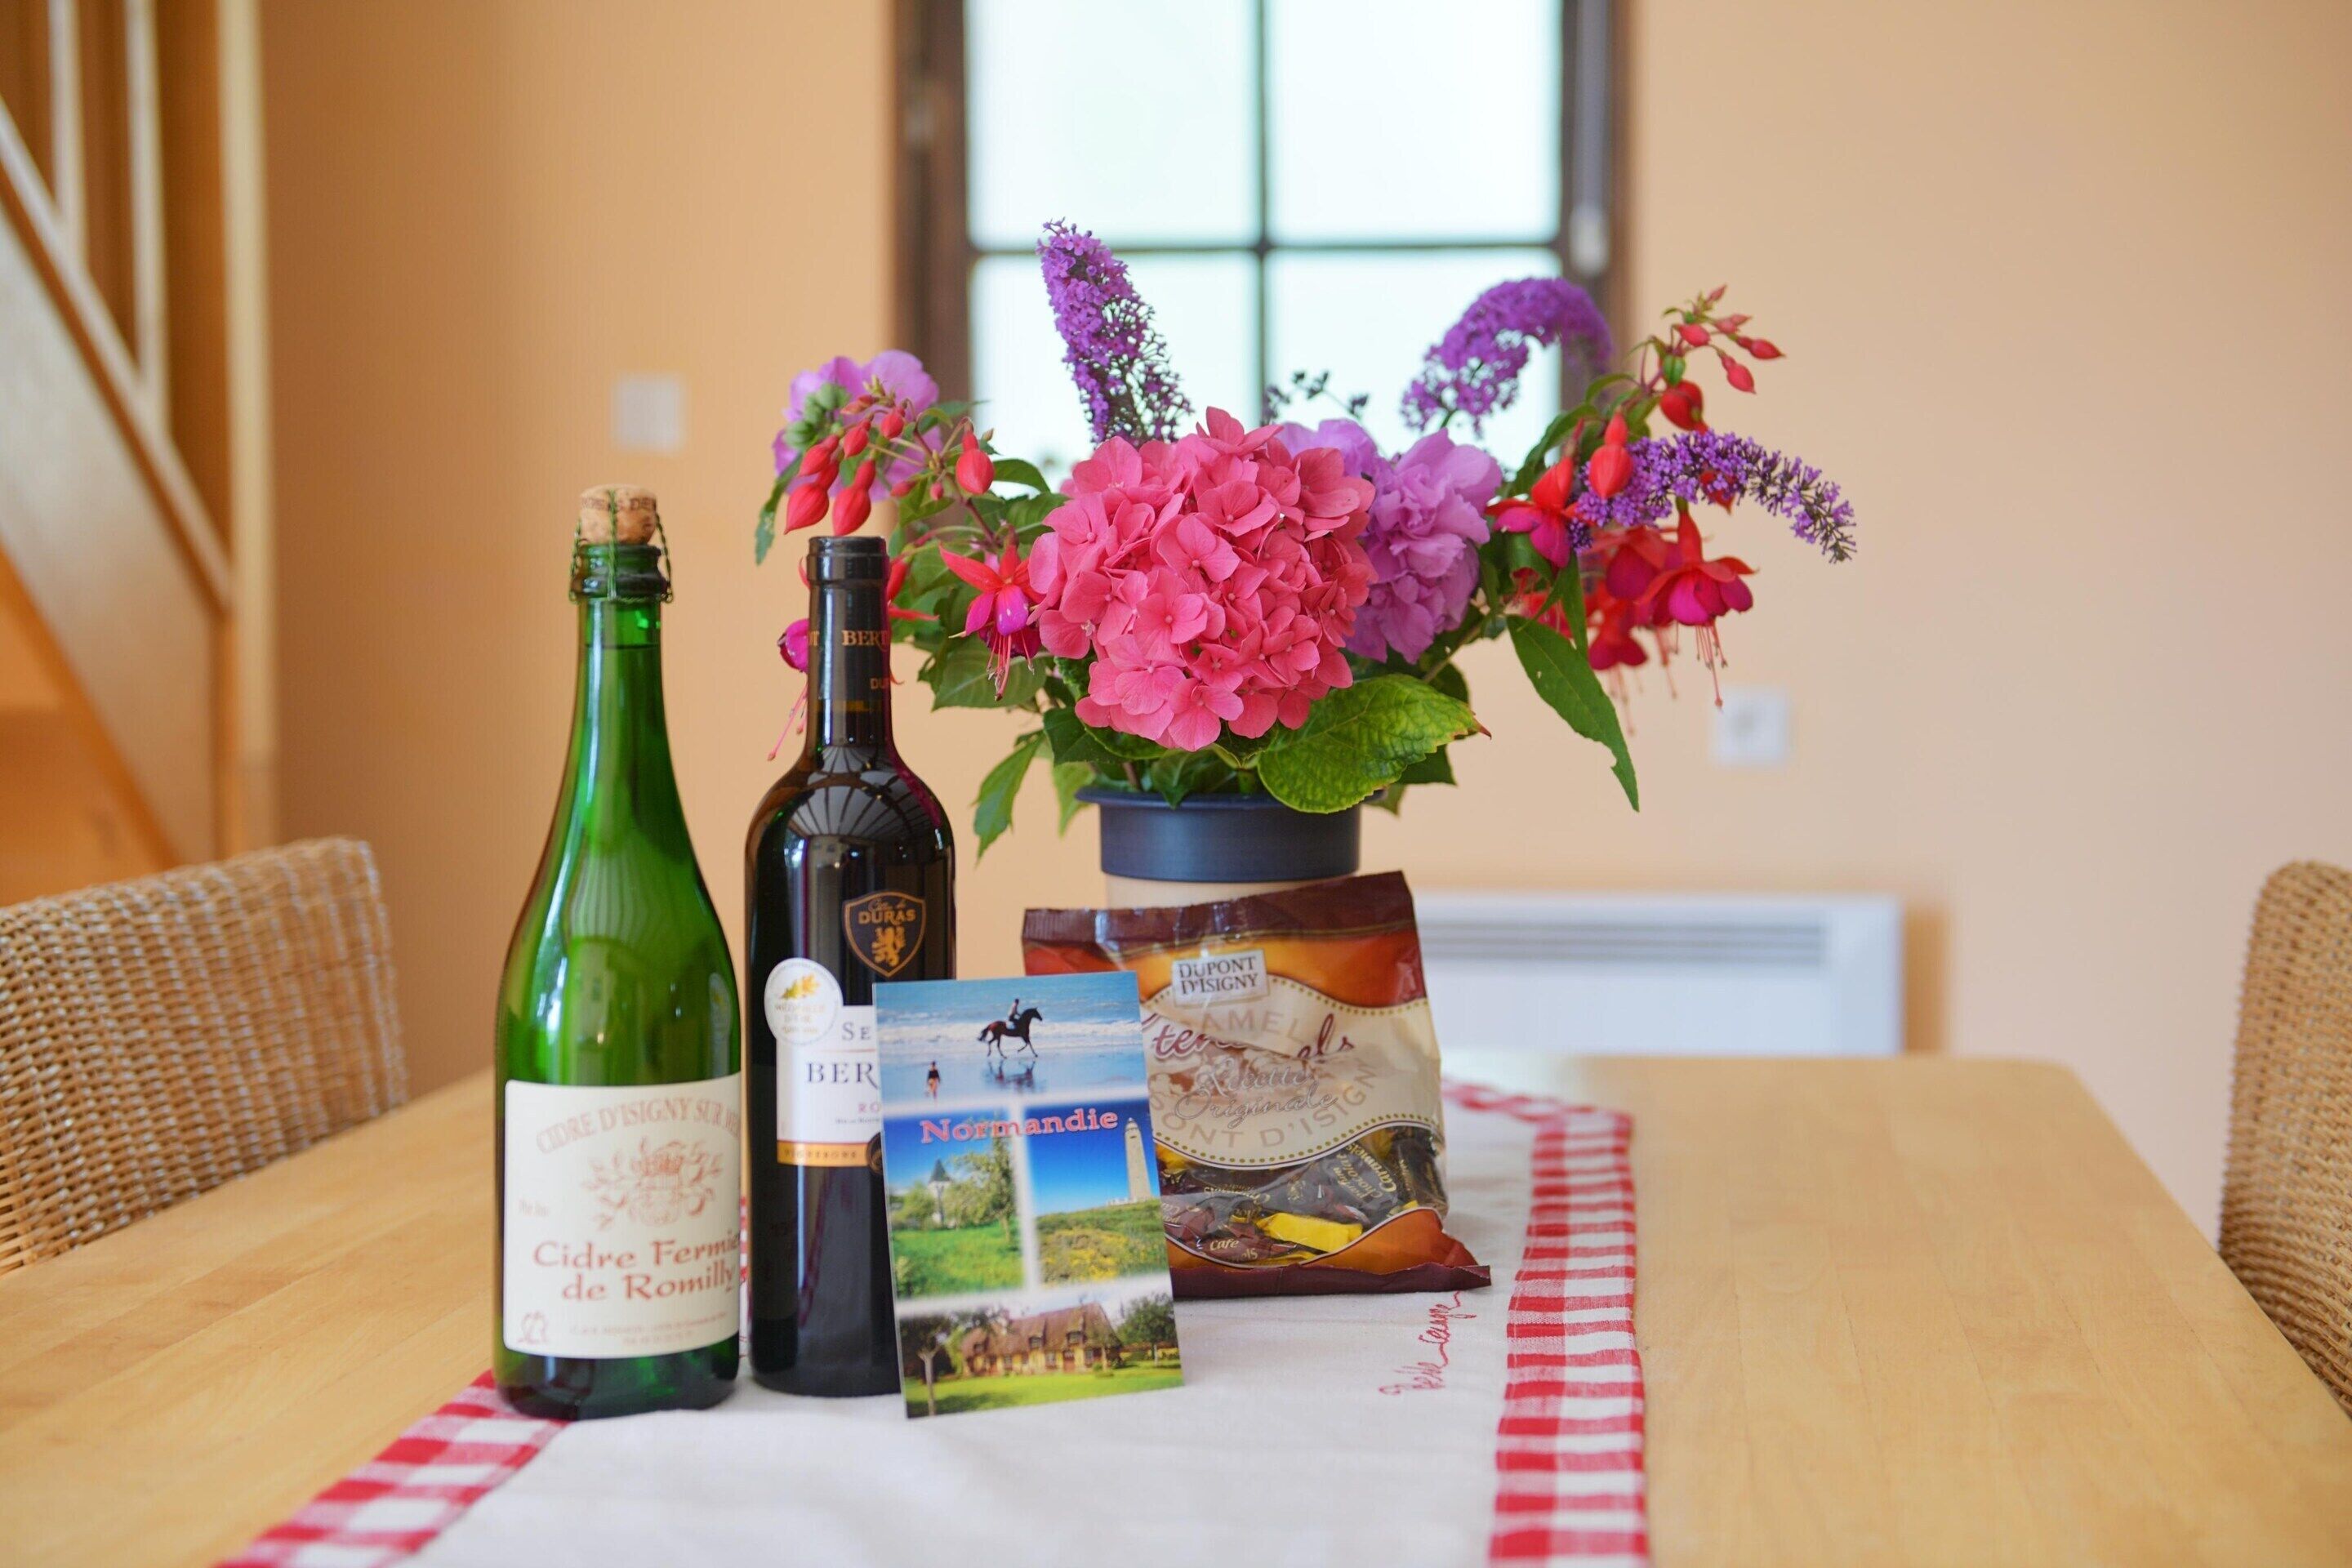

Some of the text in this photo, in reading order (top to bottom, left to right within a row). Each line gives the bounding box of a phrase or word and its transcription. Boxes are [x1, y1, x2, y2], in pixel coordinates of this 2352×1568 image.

[858, 908, 916, 925] DURAS
[1178, 956, 1257, 978] DUPONT
[1181, 973, 1258, 996] D'ISIGNY
[1174, 1080, 1339, 1129] Originale
[536, 1111, 595, 1154] CIDRE
[920, 1107, 1118, 1144] Normandie
[533, 1240, 637, 1269] Cidre
[562, 1258, 733, 1301] de Romilly
